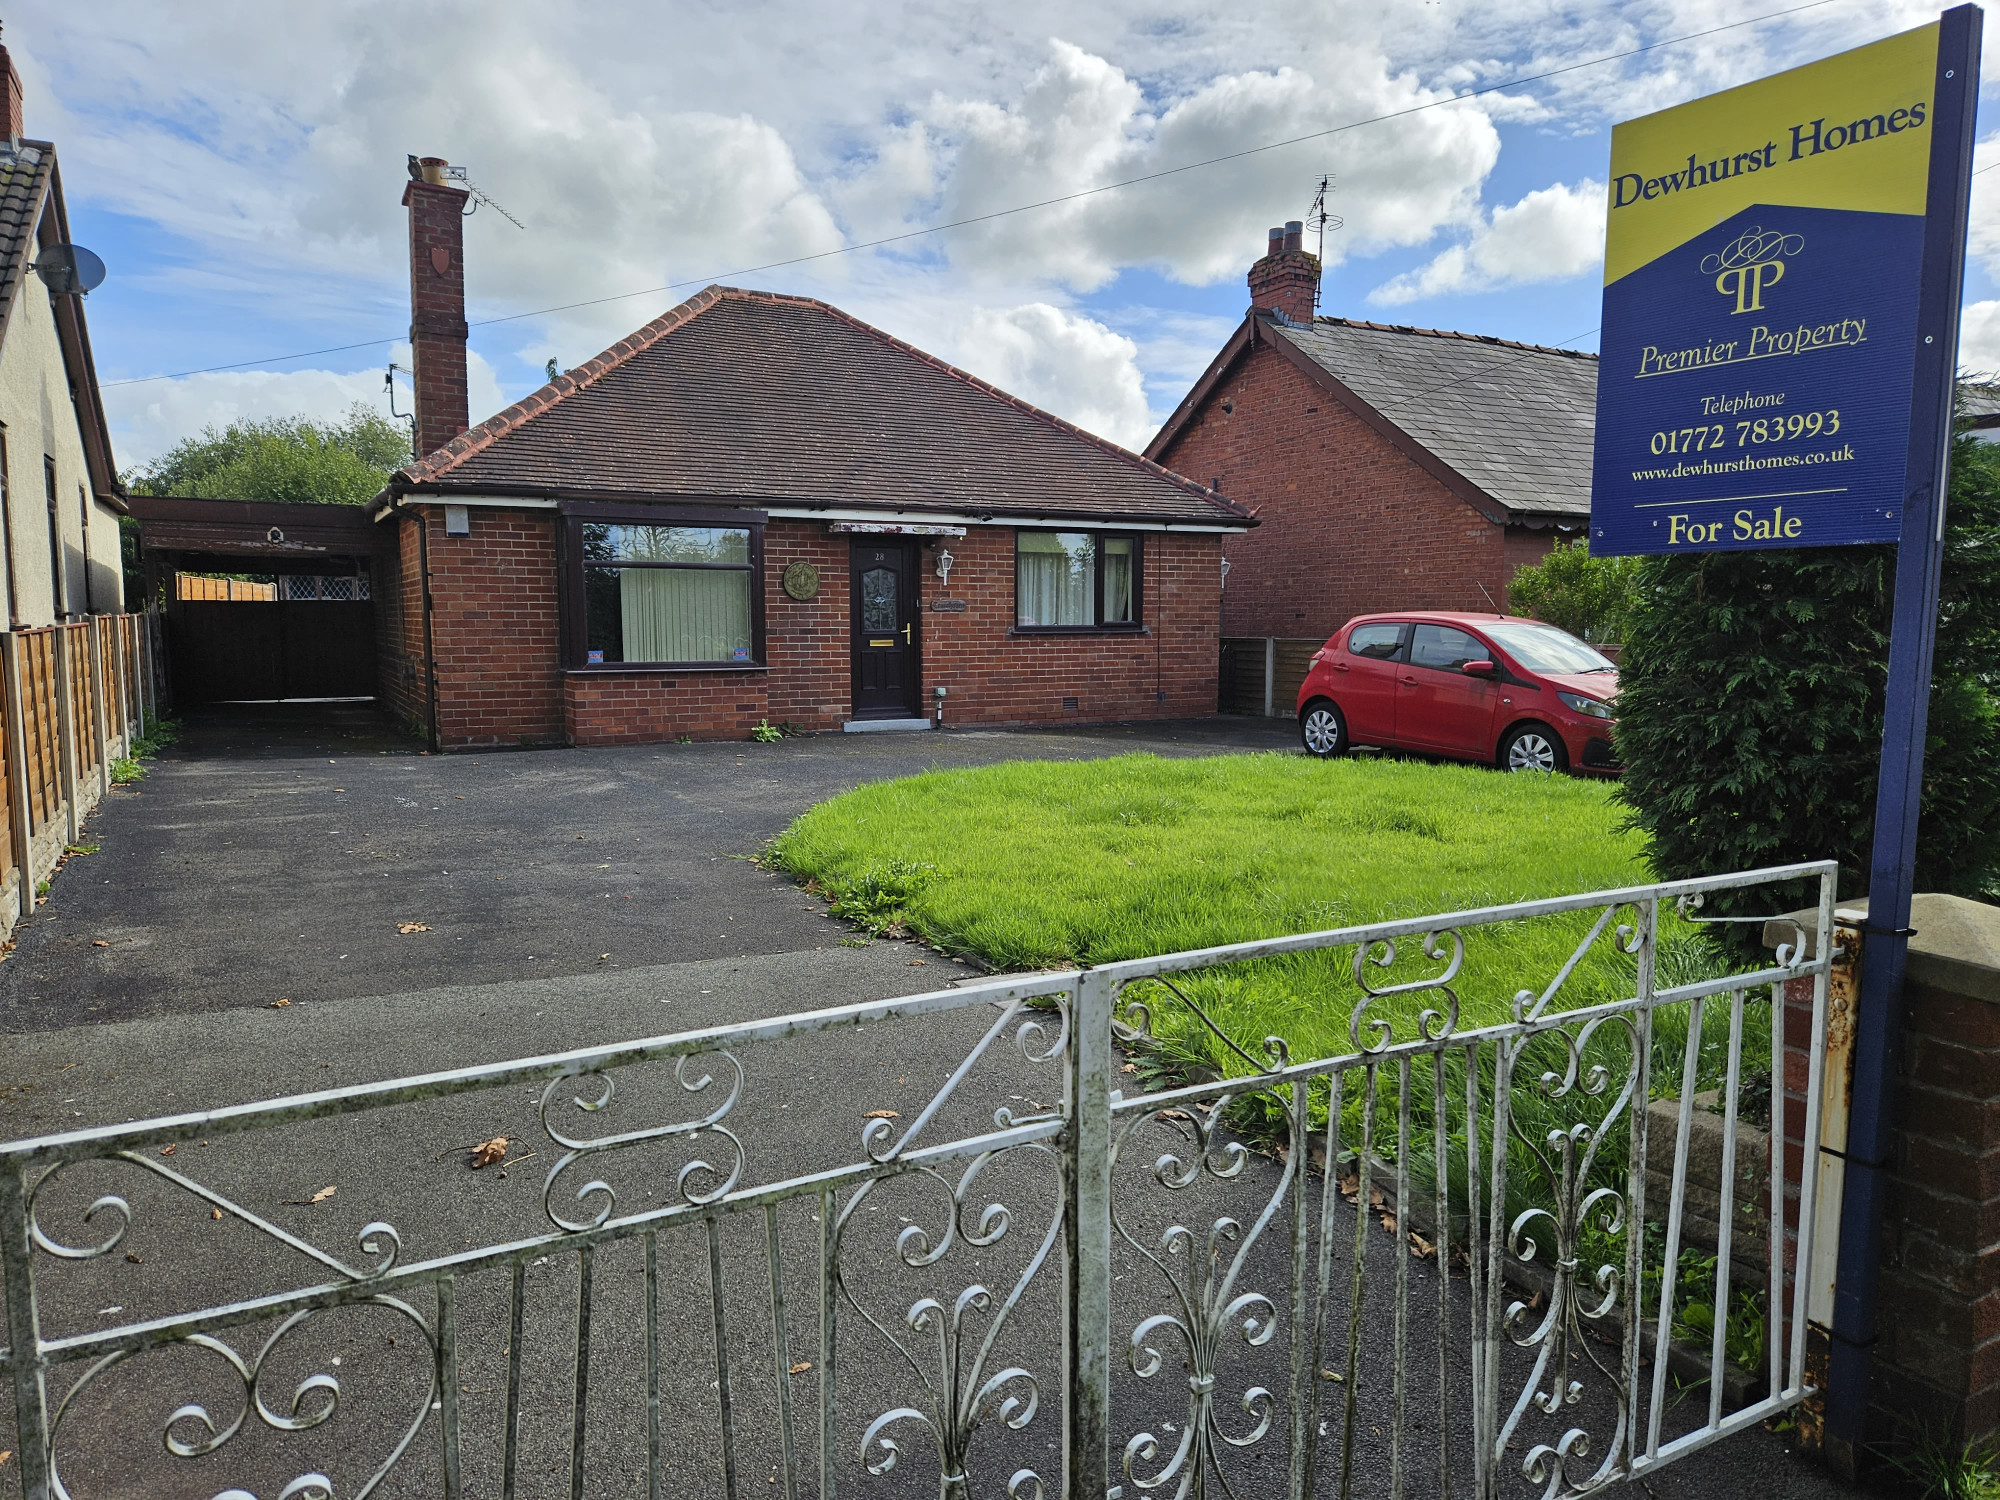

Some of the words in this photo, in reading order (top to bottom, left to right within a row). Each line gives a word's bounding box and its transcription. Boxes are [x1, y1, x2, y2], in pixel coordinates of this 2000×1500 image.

[1612, 141, 1777, 209] Dewhurst
[1787, 102, 1926, 161] Homes
[1638, 339, 1738, 375] Premier
[1747, 317, 1866, 356] Property
[1700, 391, 1785, 415] Telephone
[1650, 424, 1725, 455] 01772
[1737, 409, 1841, 447] 783993
[1632, 444, 1855, 481] www.dewhursthomes.co.uk
[1667, 514, 1723, 545] For
[1732, 506, 1803, 541] Sale
